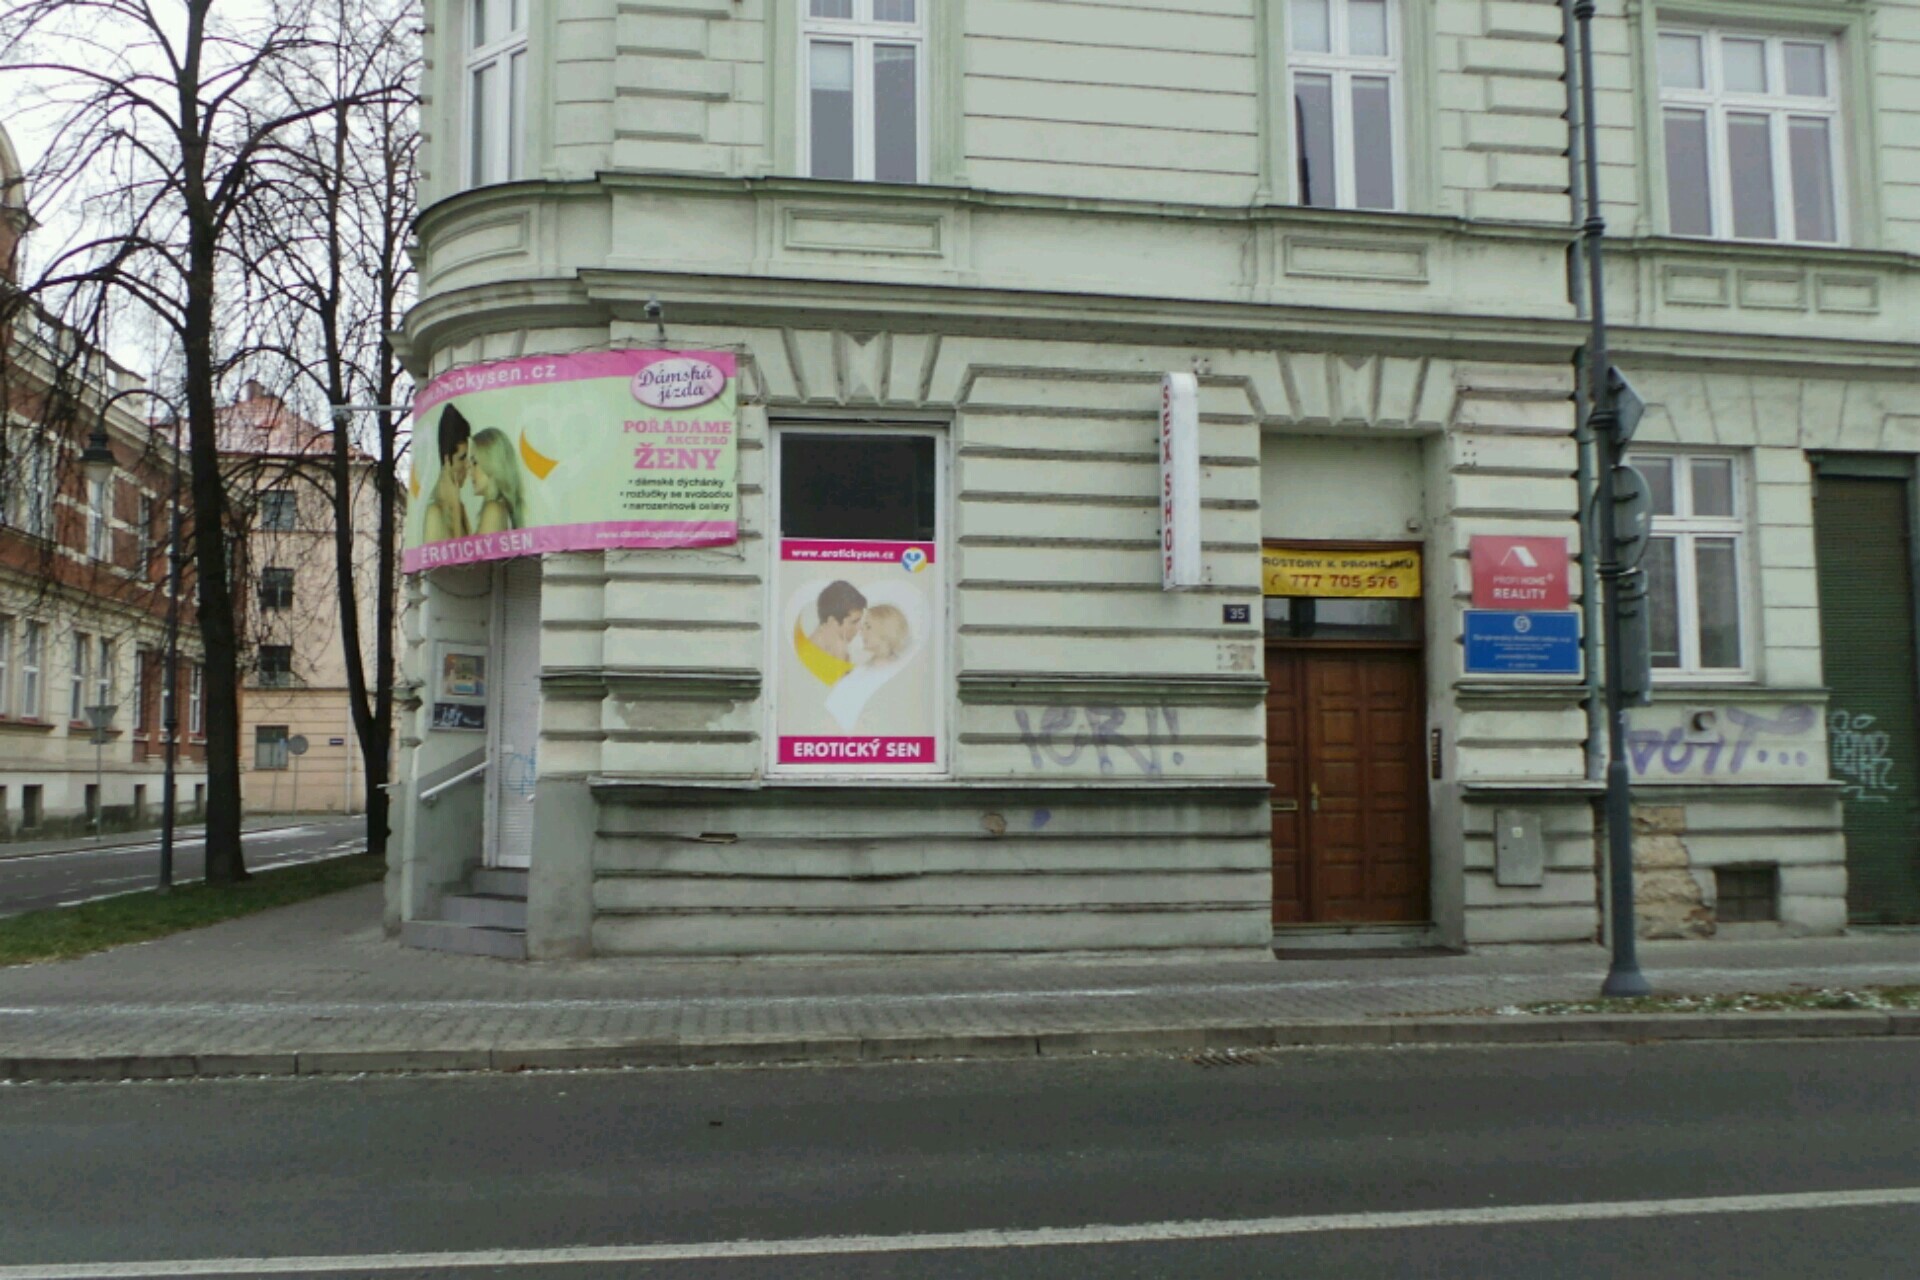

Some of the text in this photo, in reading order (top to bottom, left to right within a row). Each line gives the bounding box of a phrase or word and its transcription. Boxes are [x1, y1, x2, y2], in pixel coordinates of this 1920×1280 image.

[623, 417, 732, 434] POŘÁDÁME
[634, 442, 721, 470] ŽENY
[1164, 472, 1173, 579] SHOP
[500, 531, 532, 552] SEN
[791, 549, 895, 560] www.erotickysen.cz
[1262, 556, 1321, 568] ROSTORY
[1290, 573, 1398, 589] 777 705 576
[1493, 588, 1547, 600] REALITY
[1229, 607, 1246, 619] 35
[793, 739, 921, 758] EROTICKÝ SEN
